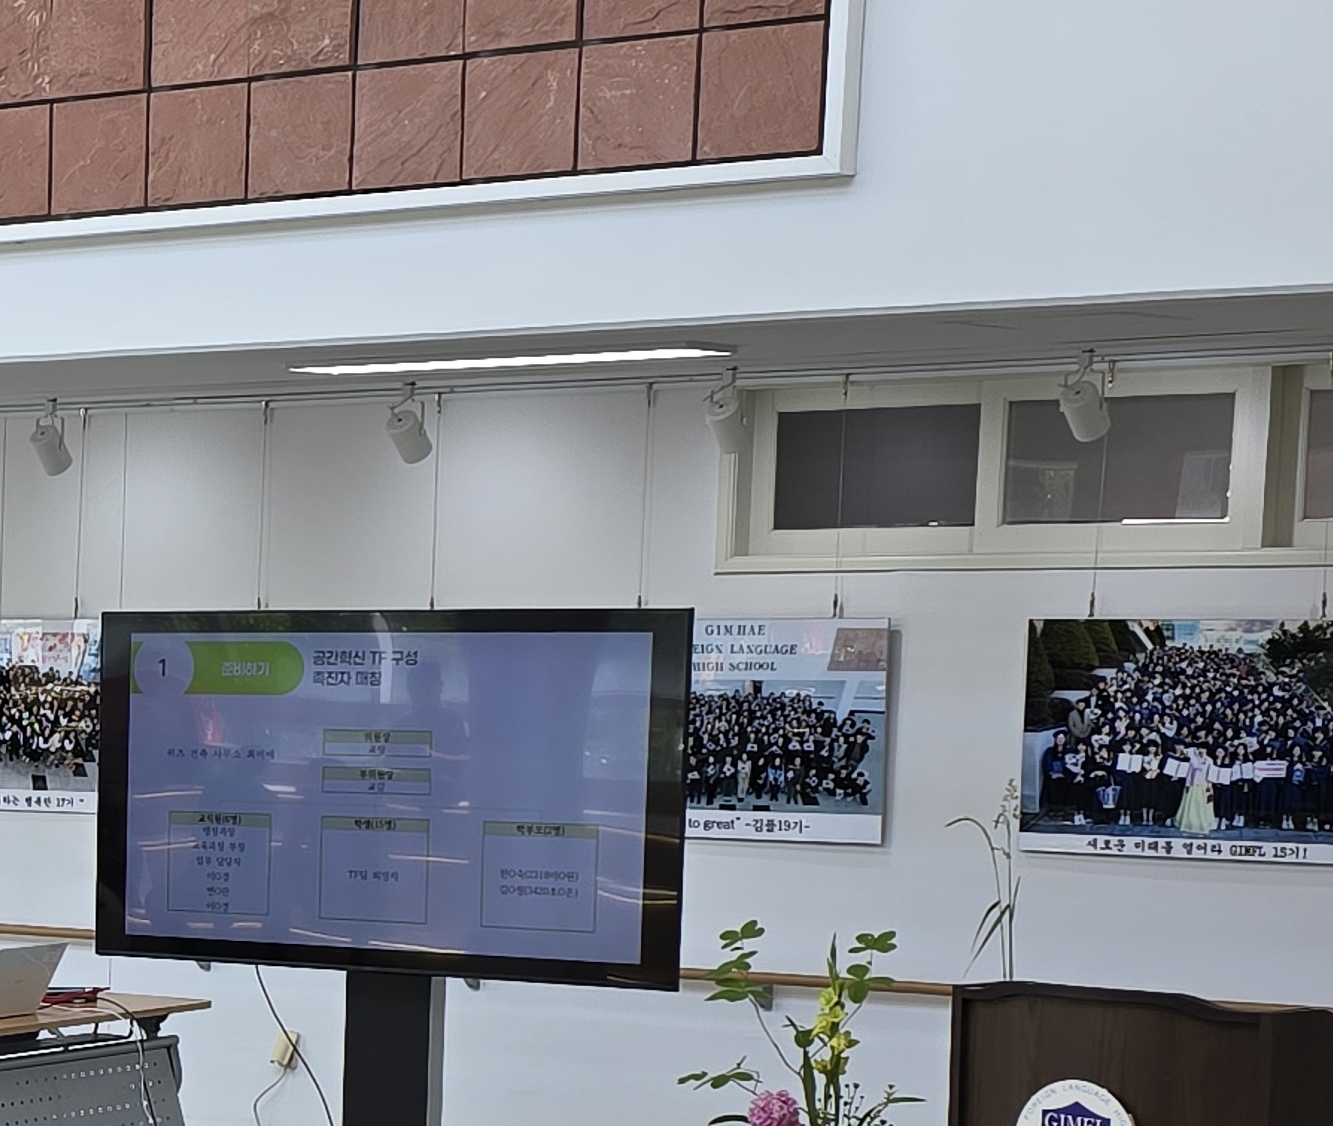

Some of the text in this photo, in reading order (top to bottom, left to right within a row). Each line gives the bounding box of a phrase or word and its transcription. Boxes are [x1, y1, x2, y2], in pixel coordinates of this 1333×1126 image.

[705, 624, 766, 637] GIMHAE
[730, 644, 798, 656] LANGUAGE
[312, 650, 419, 666] 공간혁신 TF 구성
[157, 658, 167, 678] 1
[221, 661, 271, 678] 준비하기
[729, 661, 777, 672] SCHOOL
